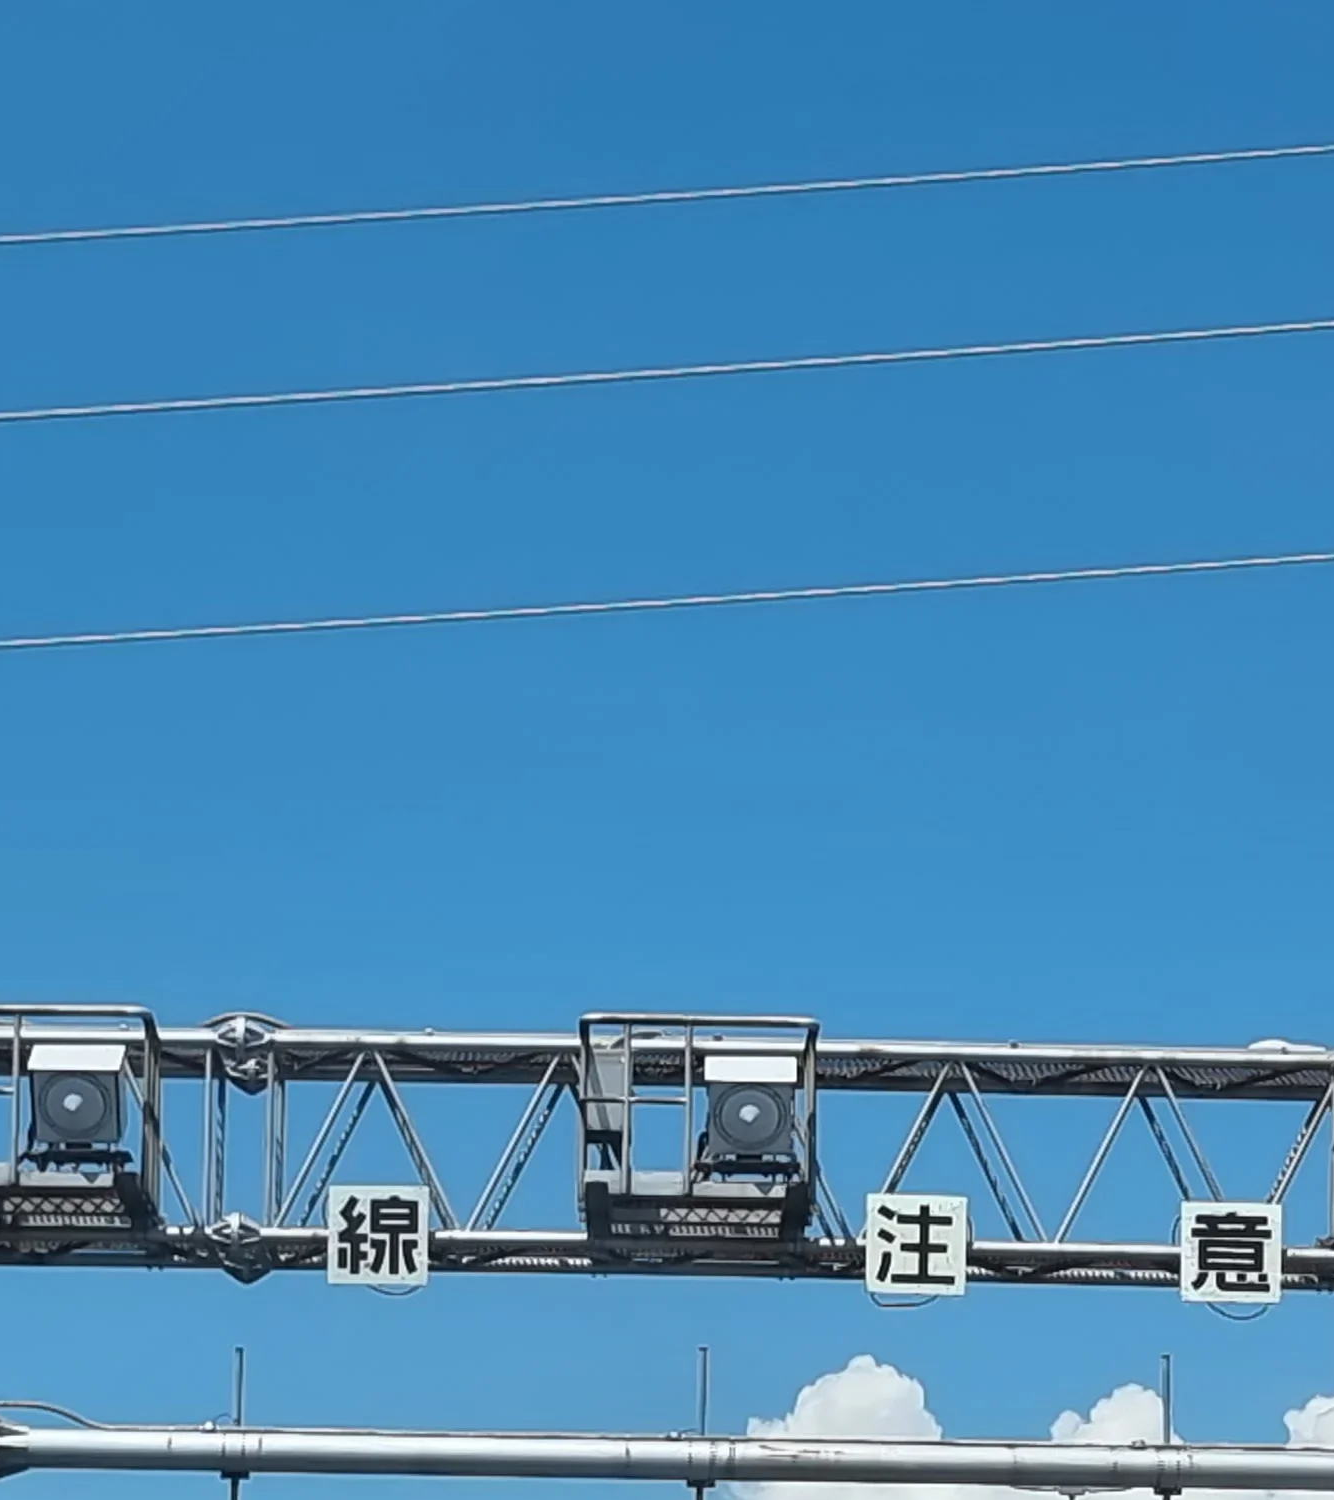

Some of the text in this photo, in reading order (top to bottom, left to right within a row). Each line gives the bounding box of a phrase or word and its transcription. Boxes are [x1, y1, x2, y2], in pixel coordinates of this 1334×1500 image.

[336, 1194, 420, 1276] 線
[875, 1203, 957, 1287] 注
[1190, 1211, 1273, 1293] 意
